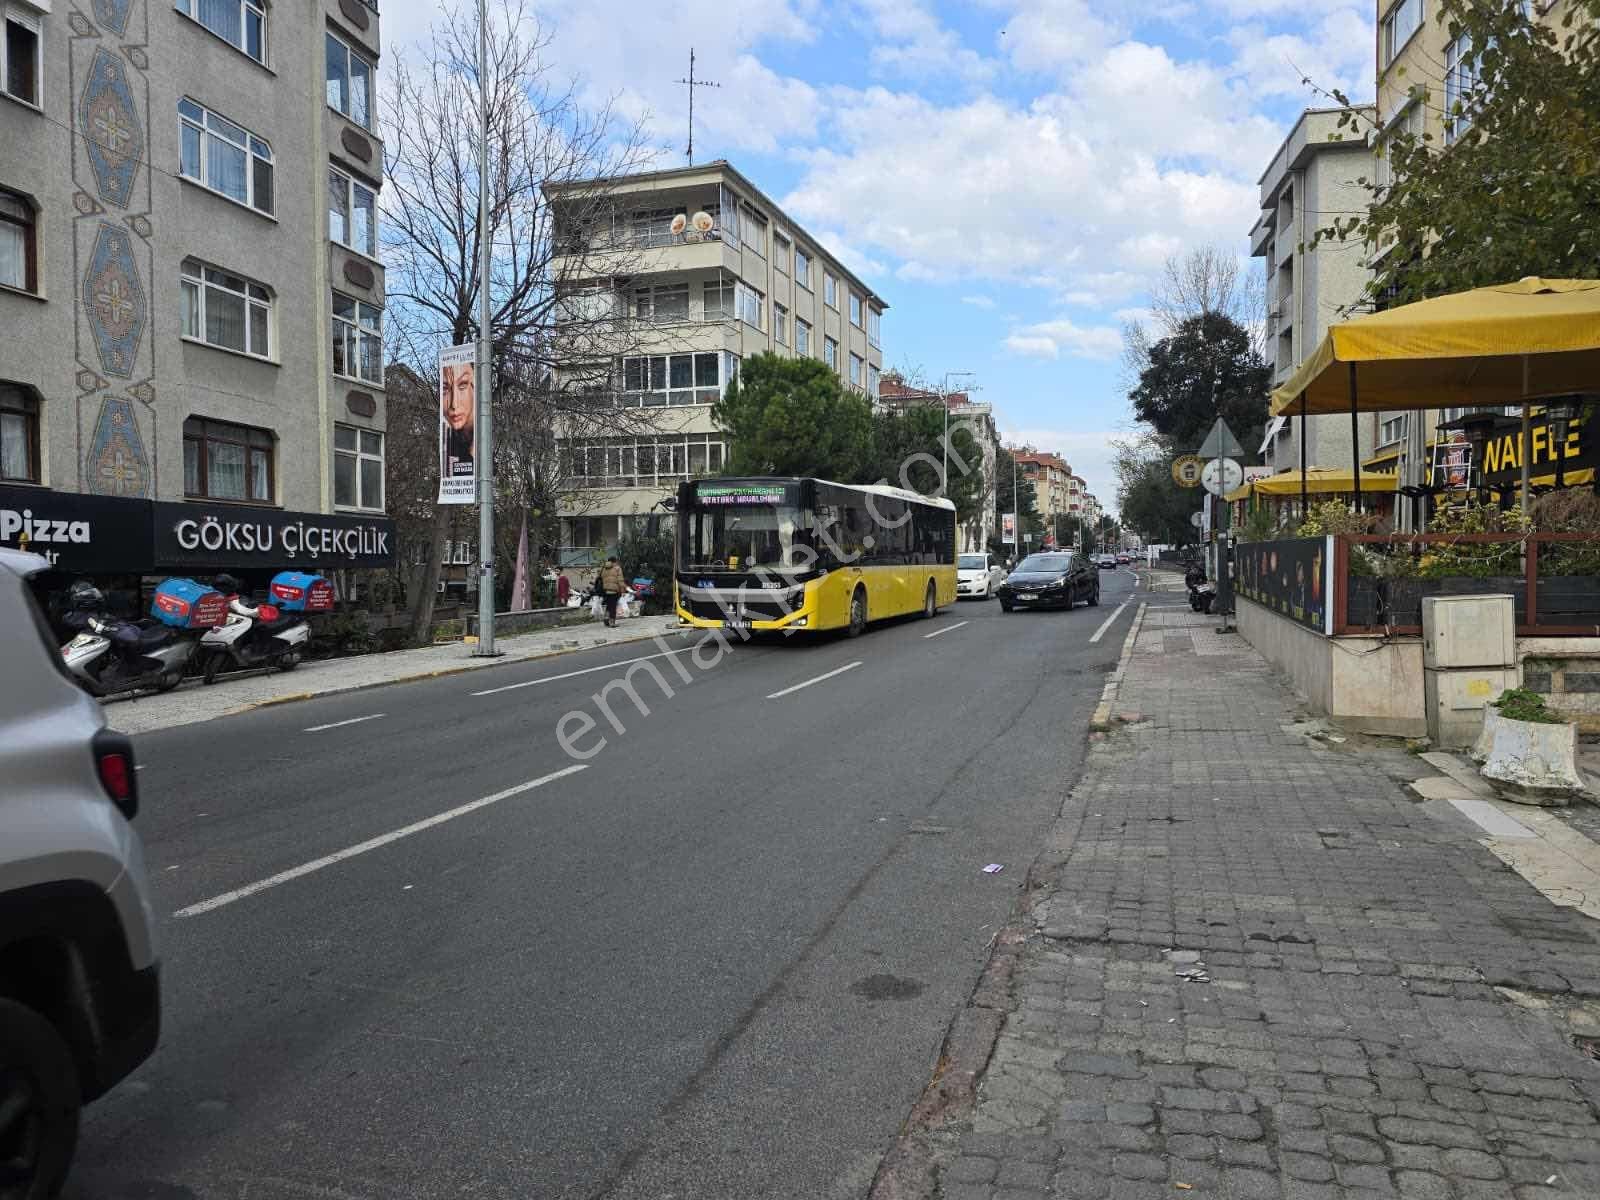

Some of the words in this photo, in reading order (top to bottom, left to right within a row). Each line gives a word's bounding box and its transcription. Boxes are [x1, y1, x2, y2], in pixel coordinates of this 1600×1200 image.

[0, 509, 91, 543] Pizza
[177, 516, 273, 551] GÖKSU
[281, 521, 389, 559] ÇİÇEKÇİLİK
